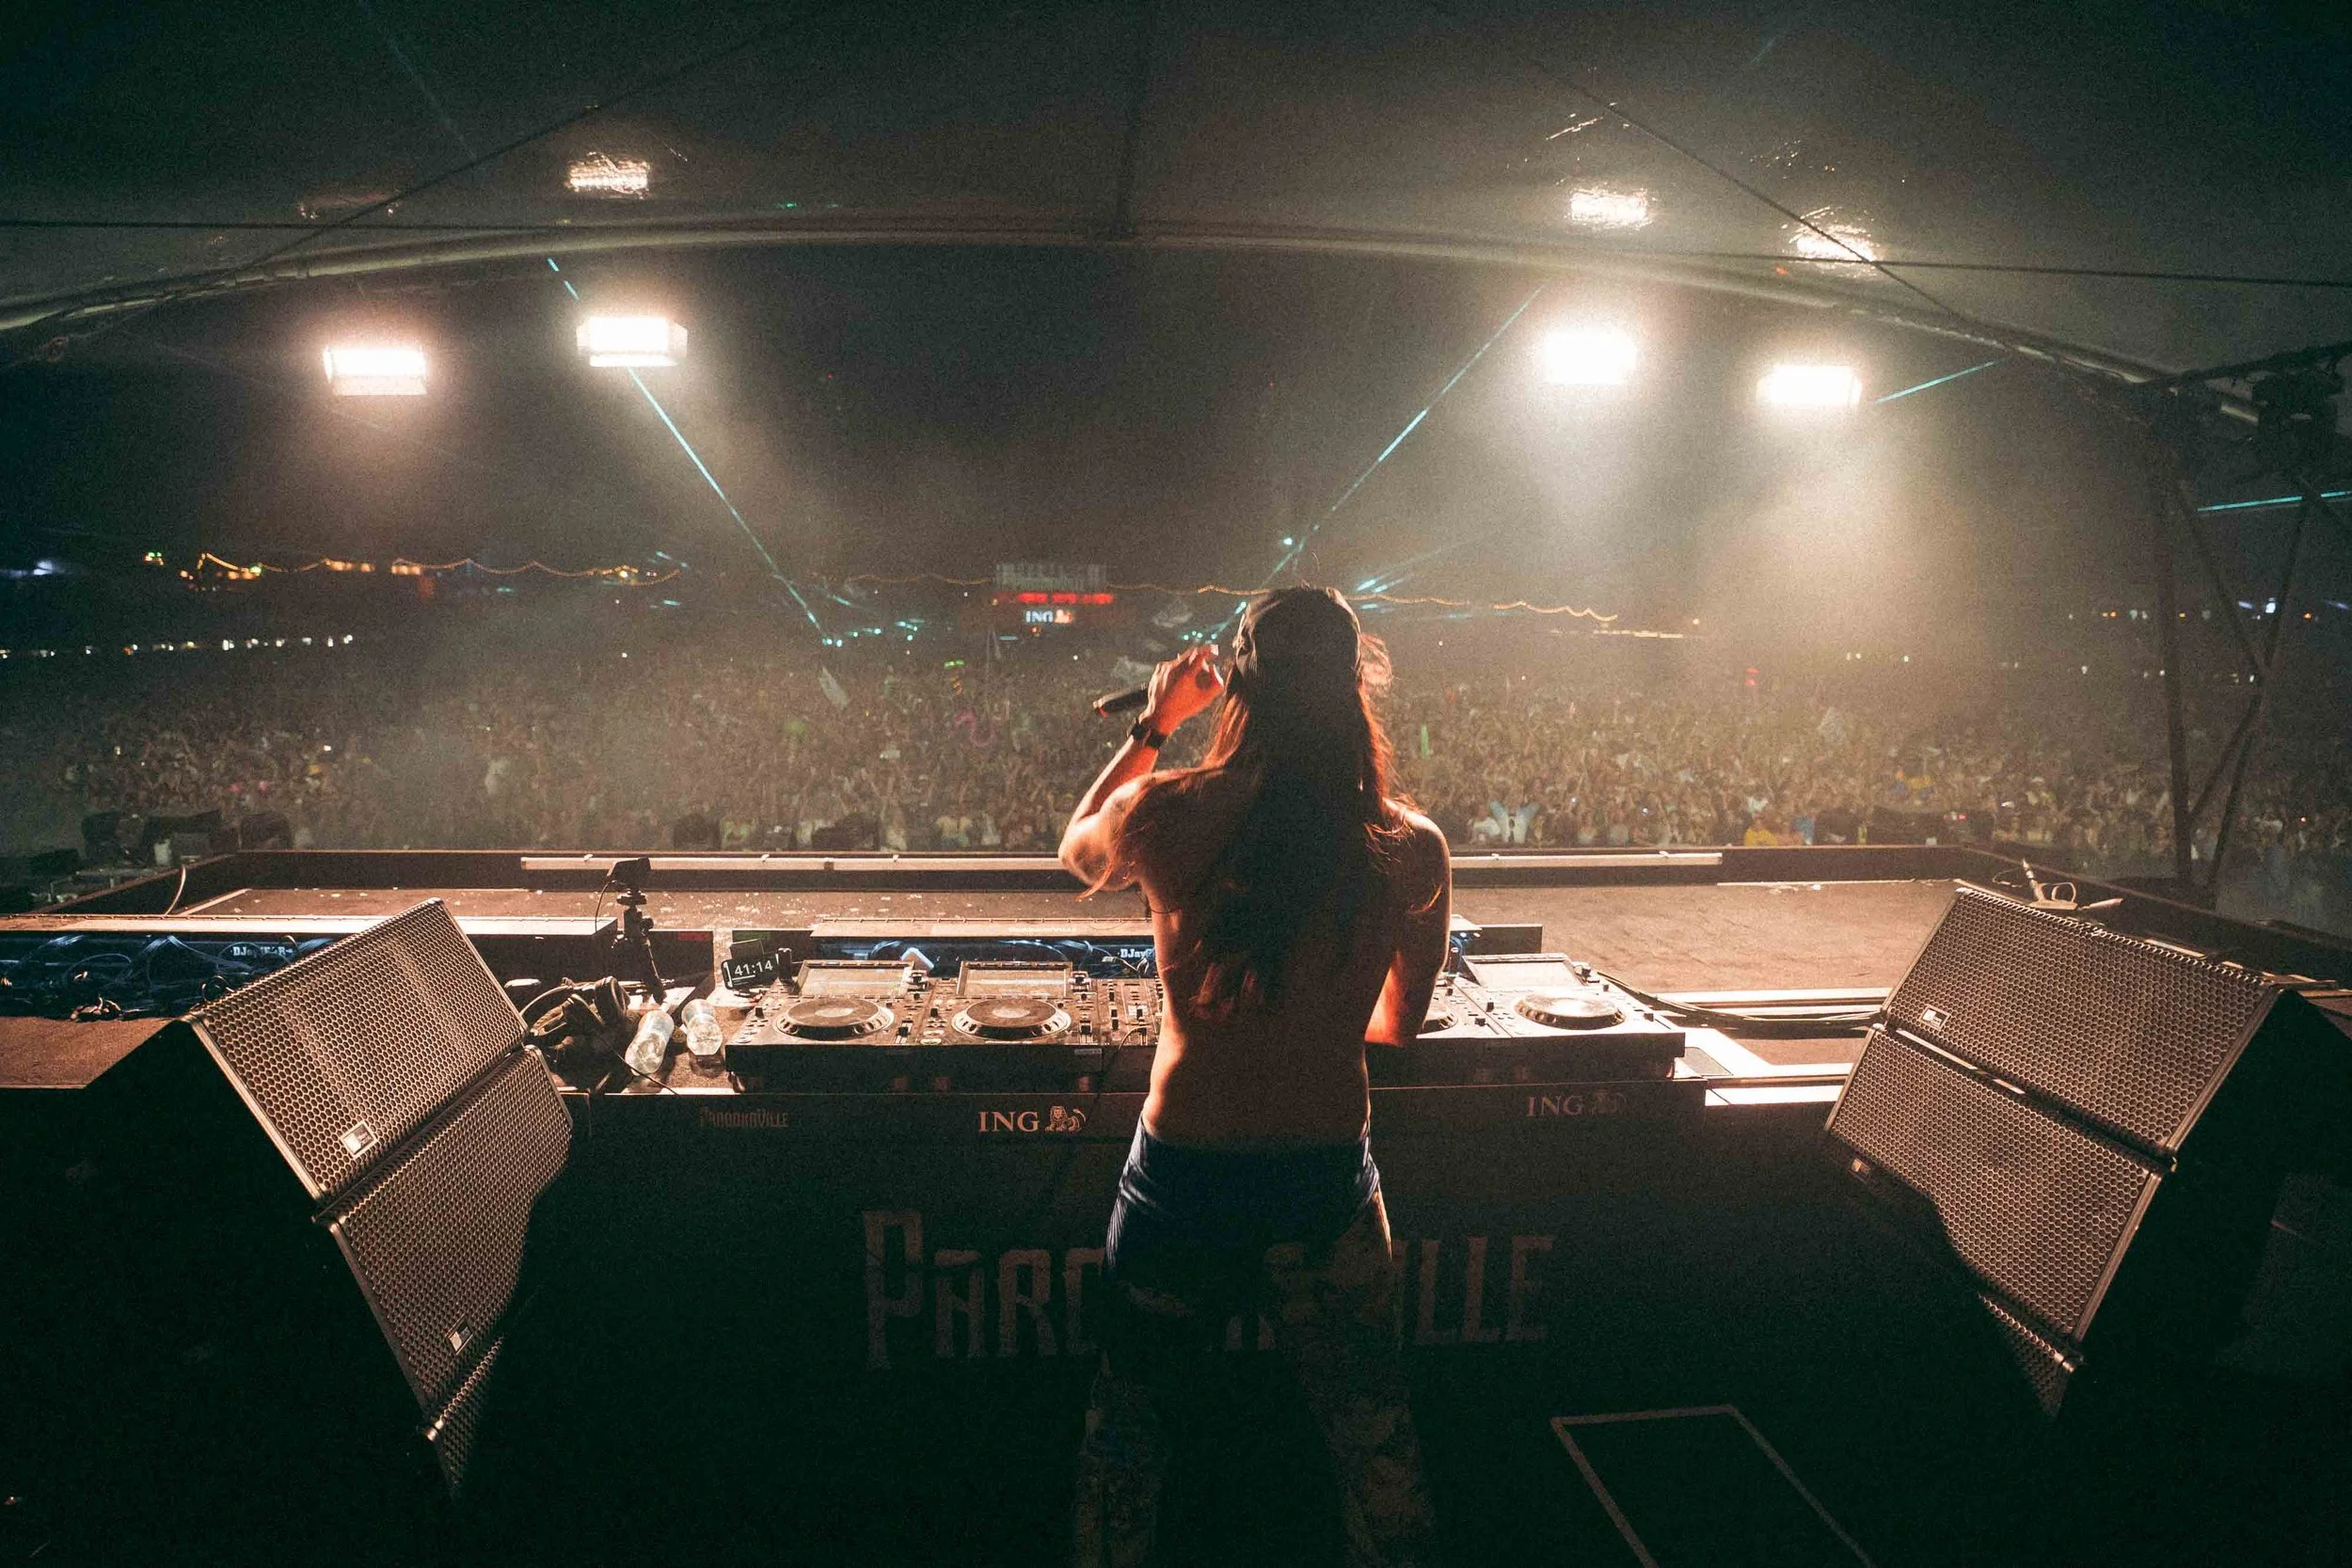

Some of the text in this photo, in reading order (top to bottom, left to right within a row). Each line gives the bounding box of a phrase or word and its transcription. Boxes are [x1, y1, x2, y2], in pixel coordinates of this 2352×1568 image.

[734, 960, 772, 975] 41:14
[1526, 1095, 1583, 1117] ING
[978, 1111, 1040, 1132] ING
[863, 1210, 1554, 1370] PAROLLE
